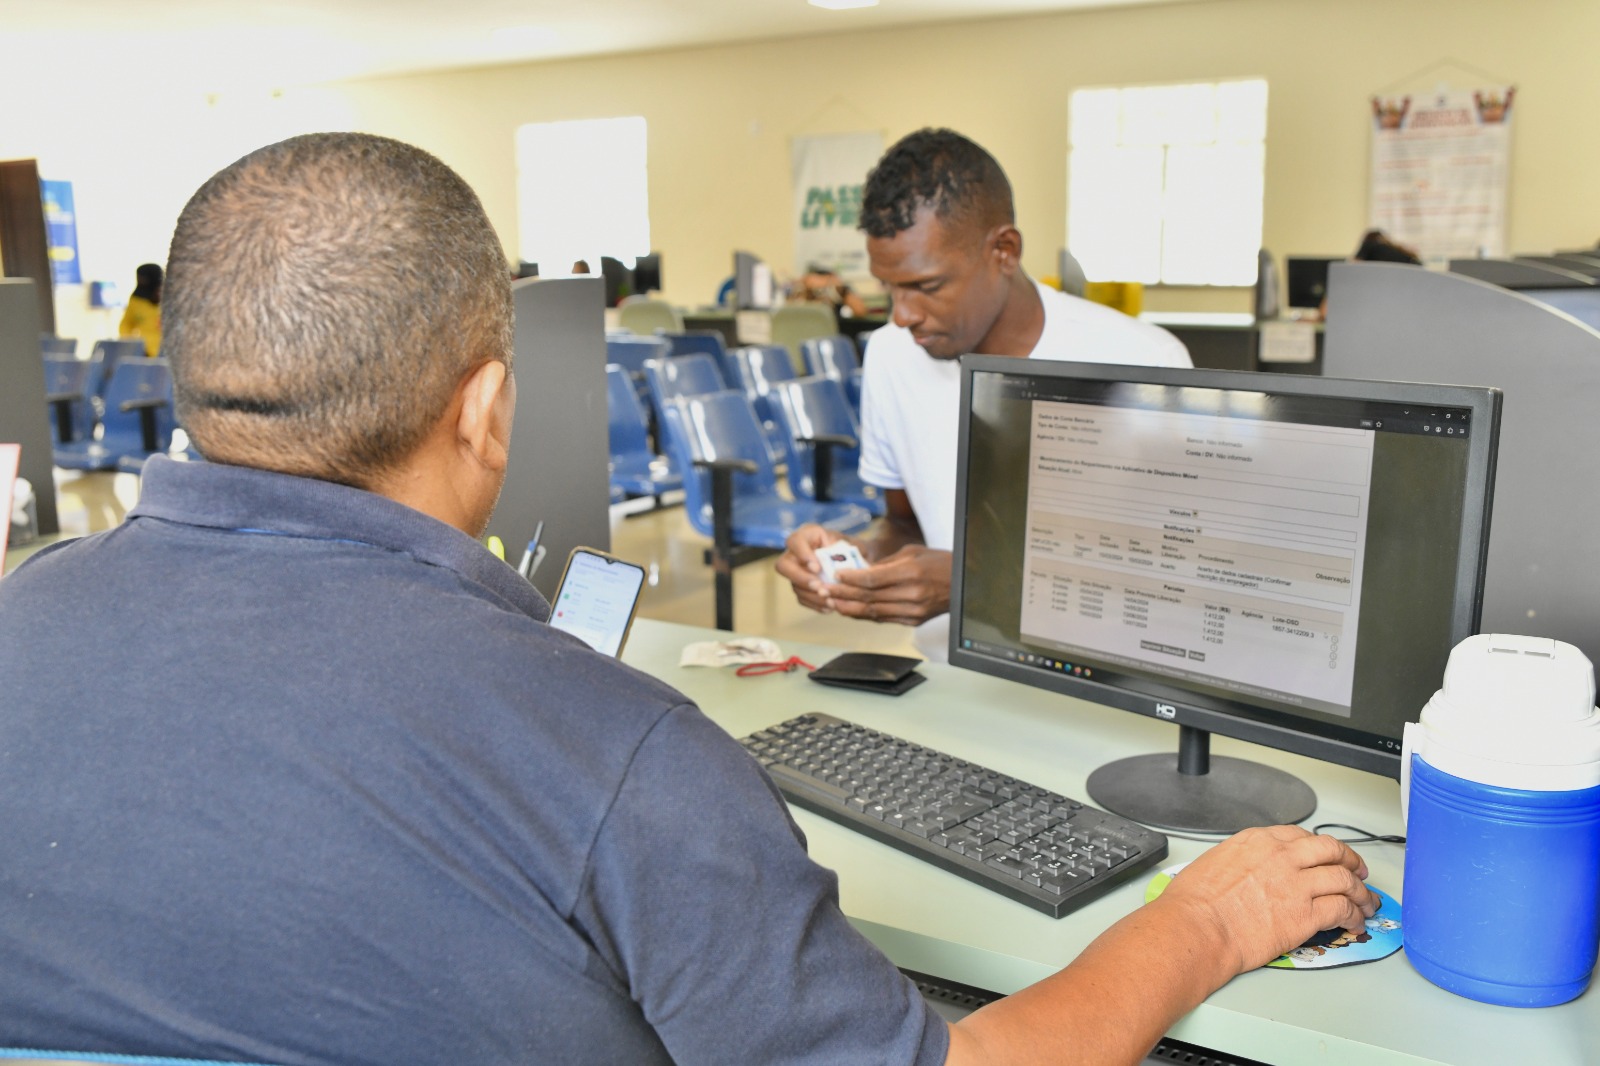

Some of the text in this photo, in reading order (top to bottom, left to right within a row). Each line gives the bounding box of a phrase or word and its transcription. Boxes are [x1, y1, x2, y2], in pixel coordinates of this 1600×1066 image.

[1164, 524, 1194, 534] Notificações
[1164, 534, 1194, 544] Notificações
[1316, 572, 1351, 584] Observação
[1204, 612, 1225, 621] 1.412,00
[1241, 610, 1264, 619] Agência
[1204, 620, 1224, 629] 1.412,00
[1272, 616, 1299, 626] Lote-DSD
[1203, 628, 1224, 636] 1.412,00
[1202, 636, 1224, 644] 1.412,00
[1156, 703, 1176, 719] HQ
